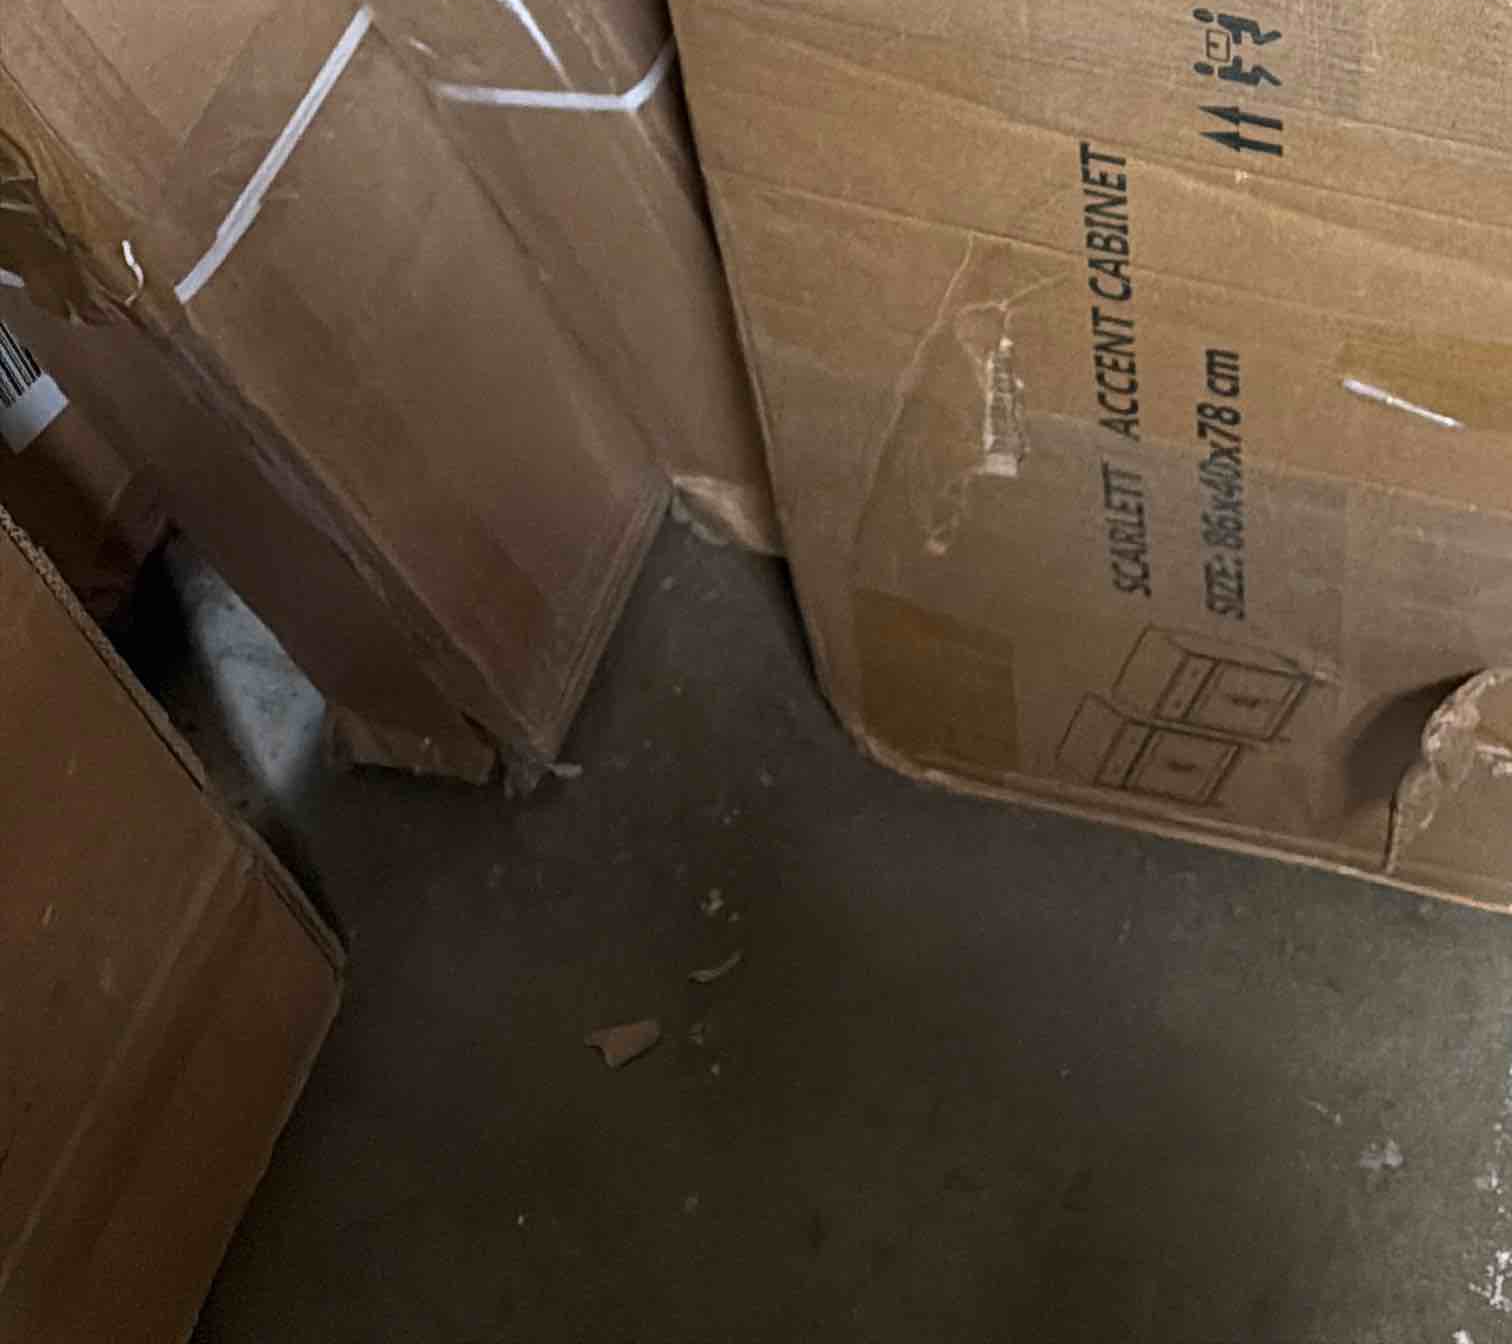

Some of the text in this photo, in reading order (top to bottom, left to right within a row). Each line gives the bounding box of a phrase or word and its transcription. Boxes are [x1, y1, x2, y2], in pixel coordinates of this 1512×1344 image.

[1079, 141, 1152, 599] SCARLETT ACCENT CABINET
[1204, 347, 1242, 399] cm
[1203, 552, 1246, 622] SIZE:
